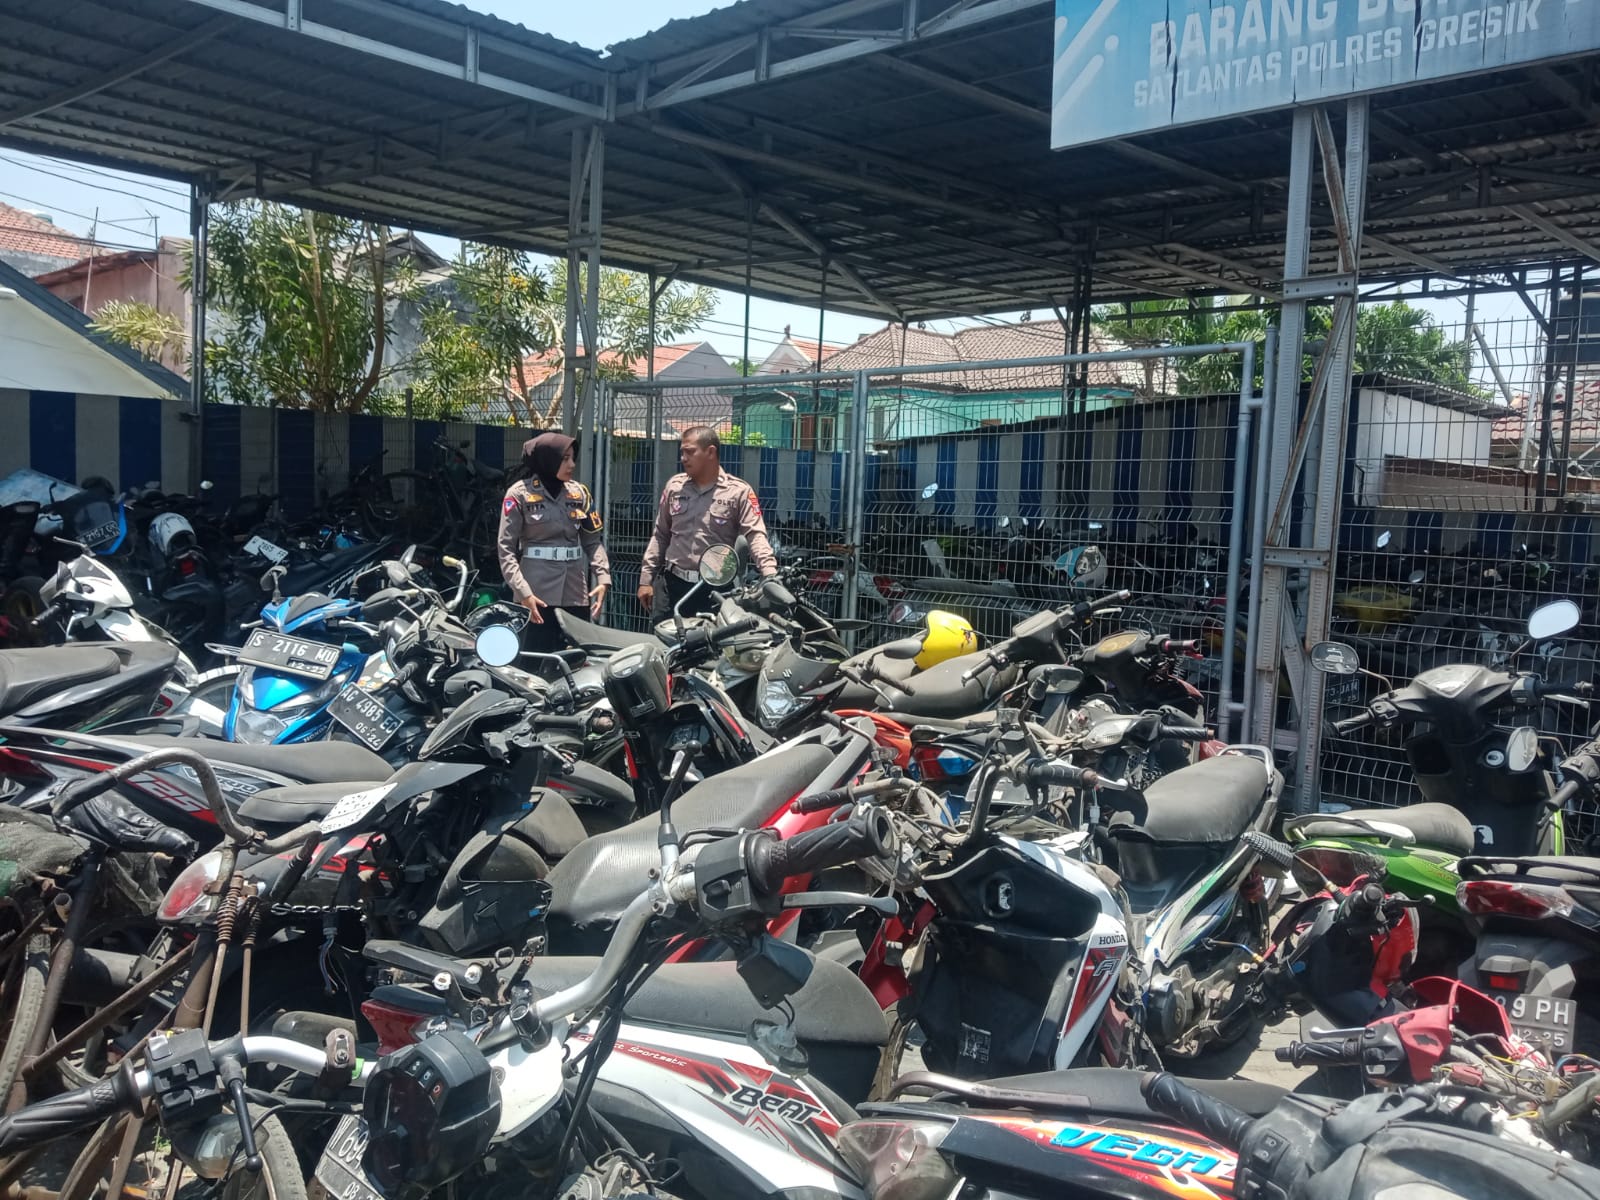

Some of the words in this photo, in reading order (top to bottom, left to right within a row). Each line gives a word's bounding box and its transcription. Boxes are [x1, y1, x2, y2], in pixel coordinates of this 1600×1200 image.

[1134, 51, 1282, 107] SATLANTAS
[1291, 27, 1402, 79] POLRES
[1419, 0, 1539, 51] GRESIK
[1150, 0, 1338, 67] BARANG
[253, 635, 265, 647] S
[272, 640, 309, 656] 2116
[315, 648, 338, 664] MU
[341, 685, 359, 702] AG
[355, 698, 384, 722] 4985
[379, 717, 398, 734] EC
[1099, 935, 1126, 945] HONDA
[1535, 999, 1570, 1025] PH
[1050, 1127, 1221, 1174] VEGA
